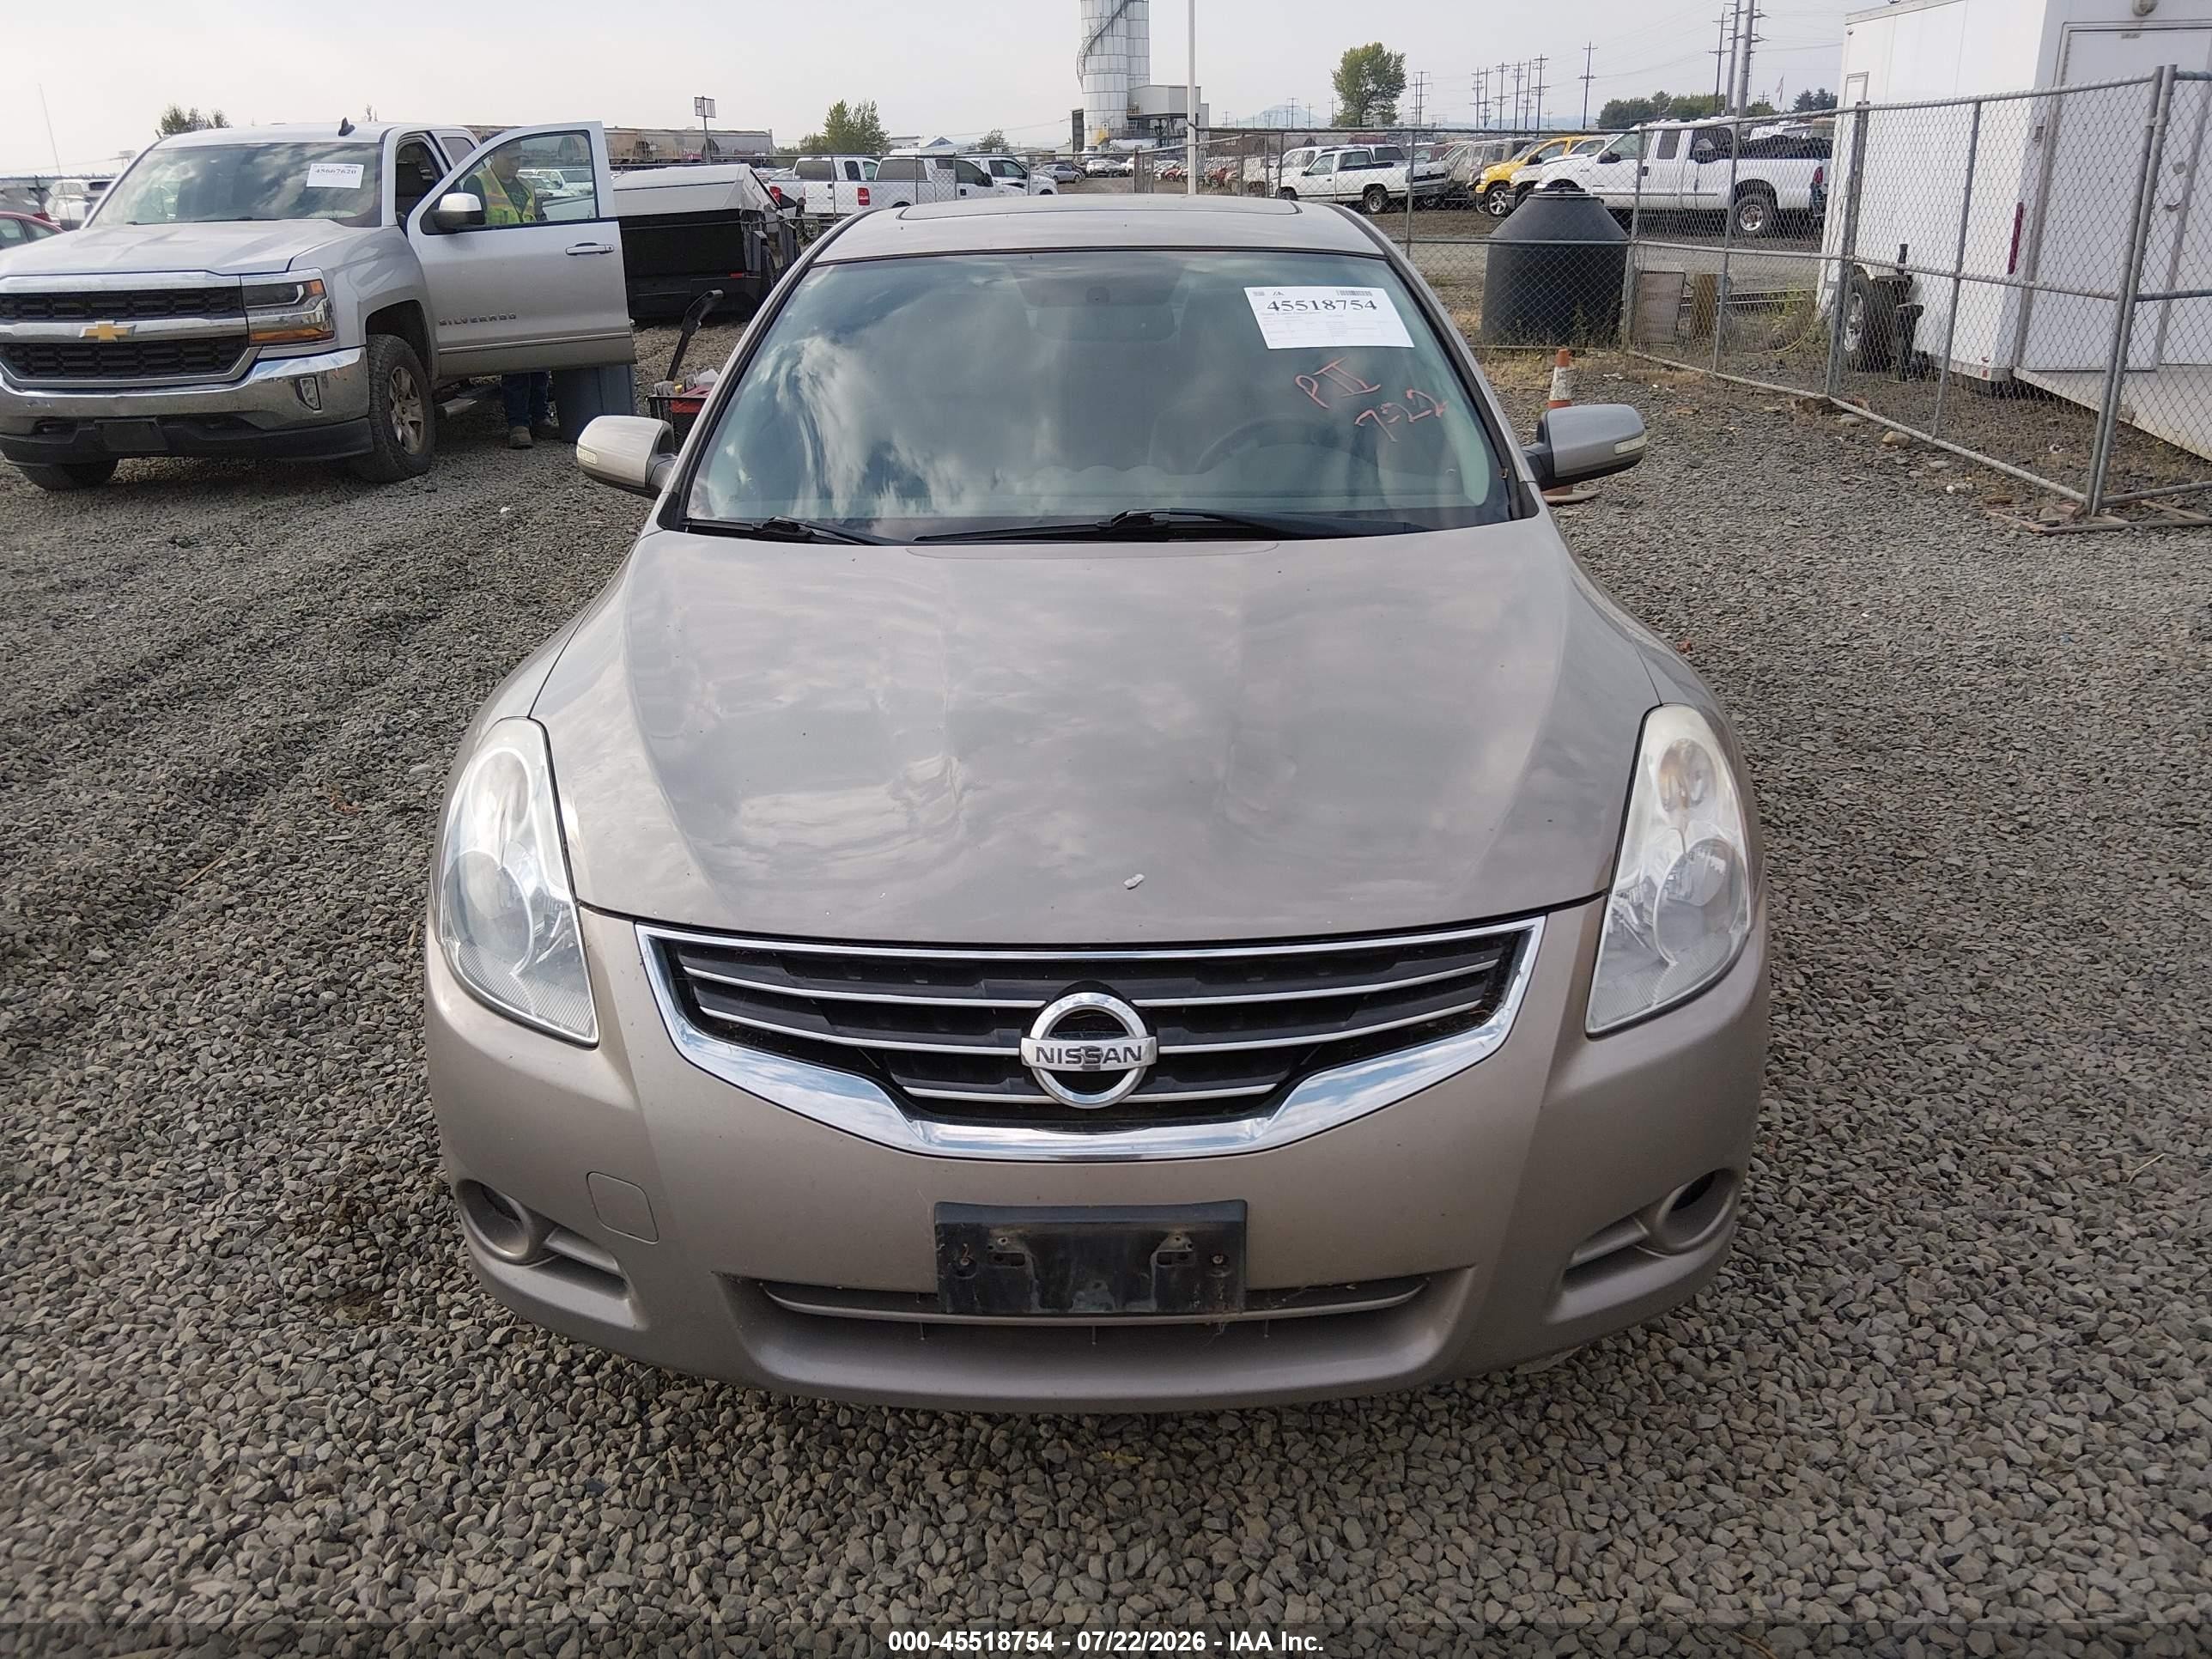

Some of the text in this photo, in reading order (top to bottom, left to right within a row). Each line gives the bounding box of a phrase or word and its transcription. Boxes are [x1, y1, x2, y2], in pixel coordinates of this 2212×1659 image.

[1267, 299, 1377, 312] 45518754
[439, 313, 517, 326] SILVERADO
[1036, 1045, 1142, 1065] NISSAN
